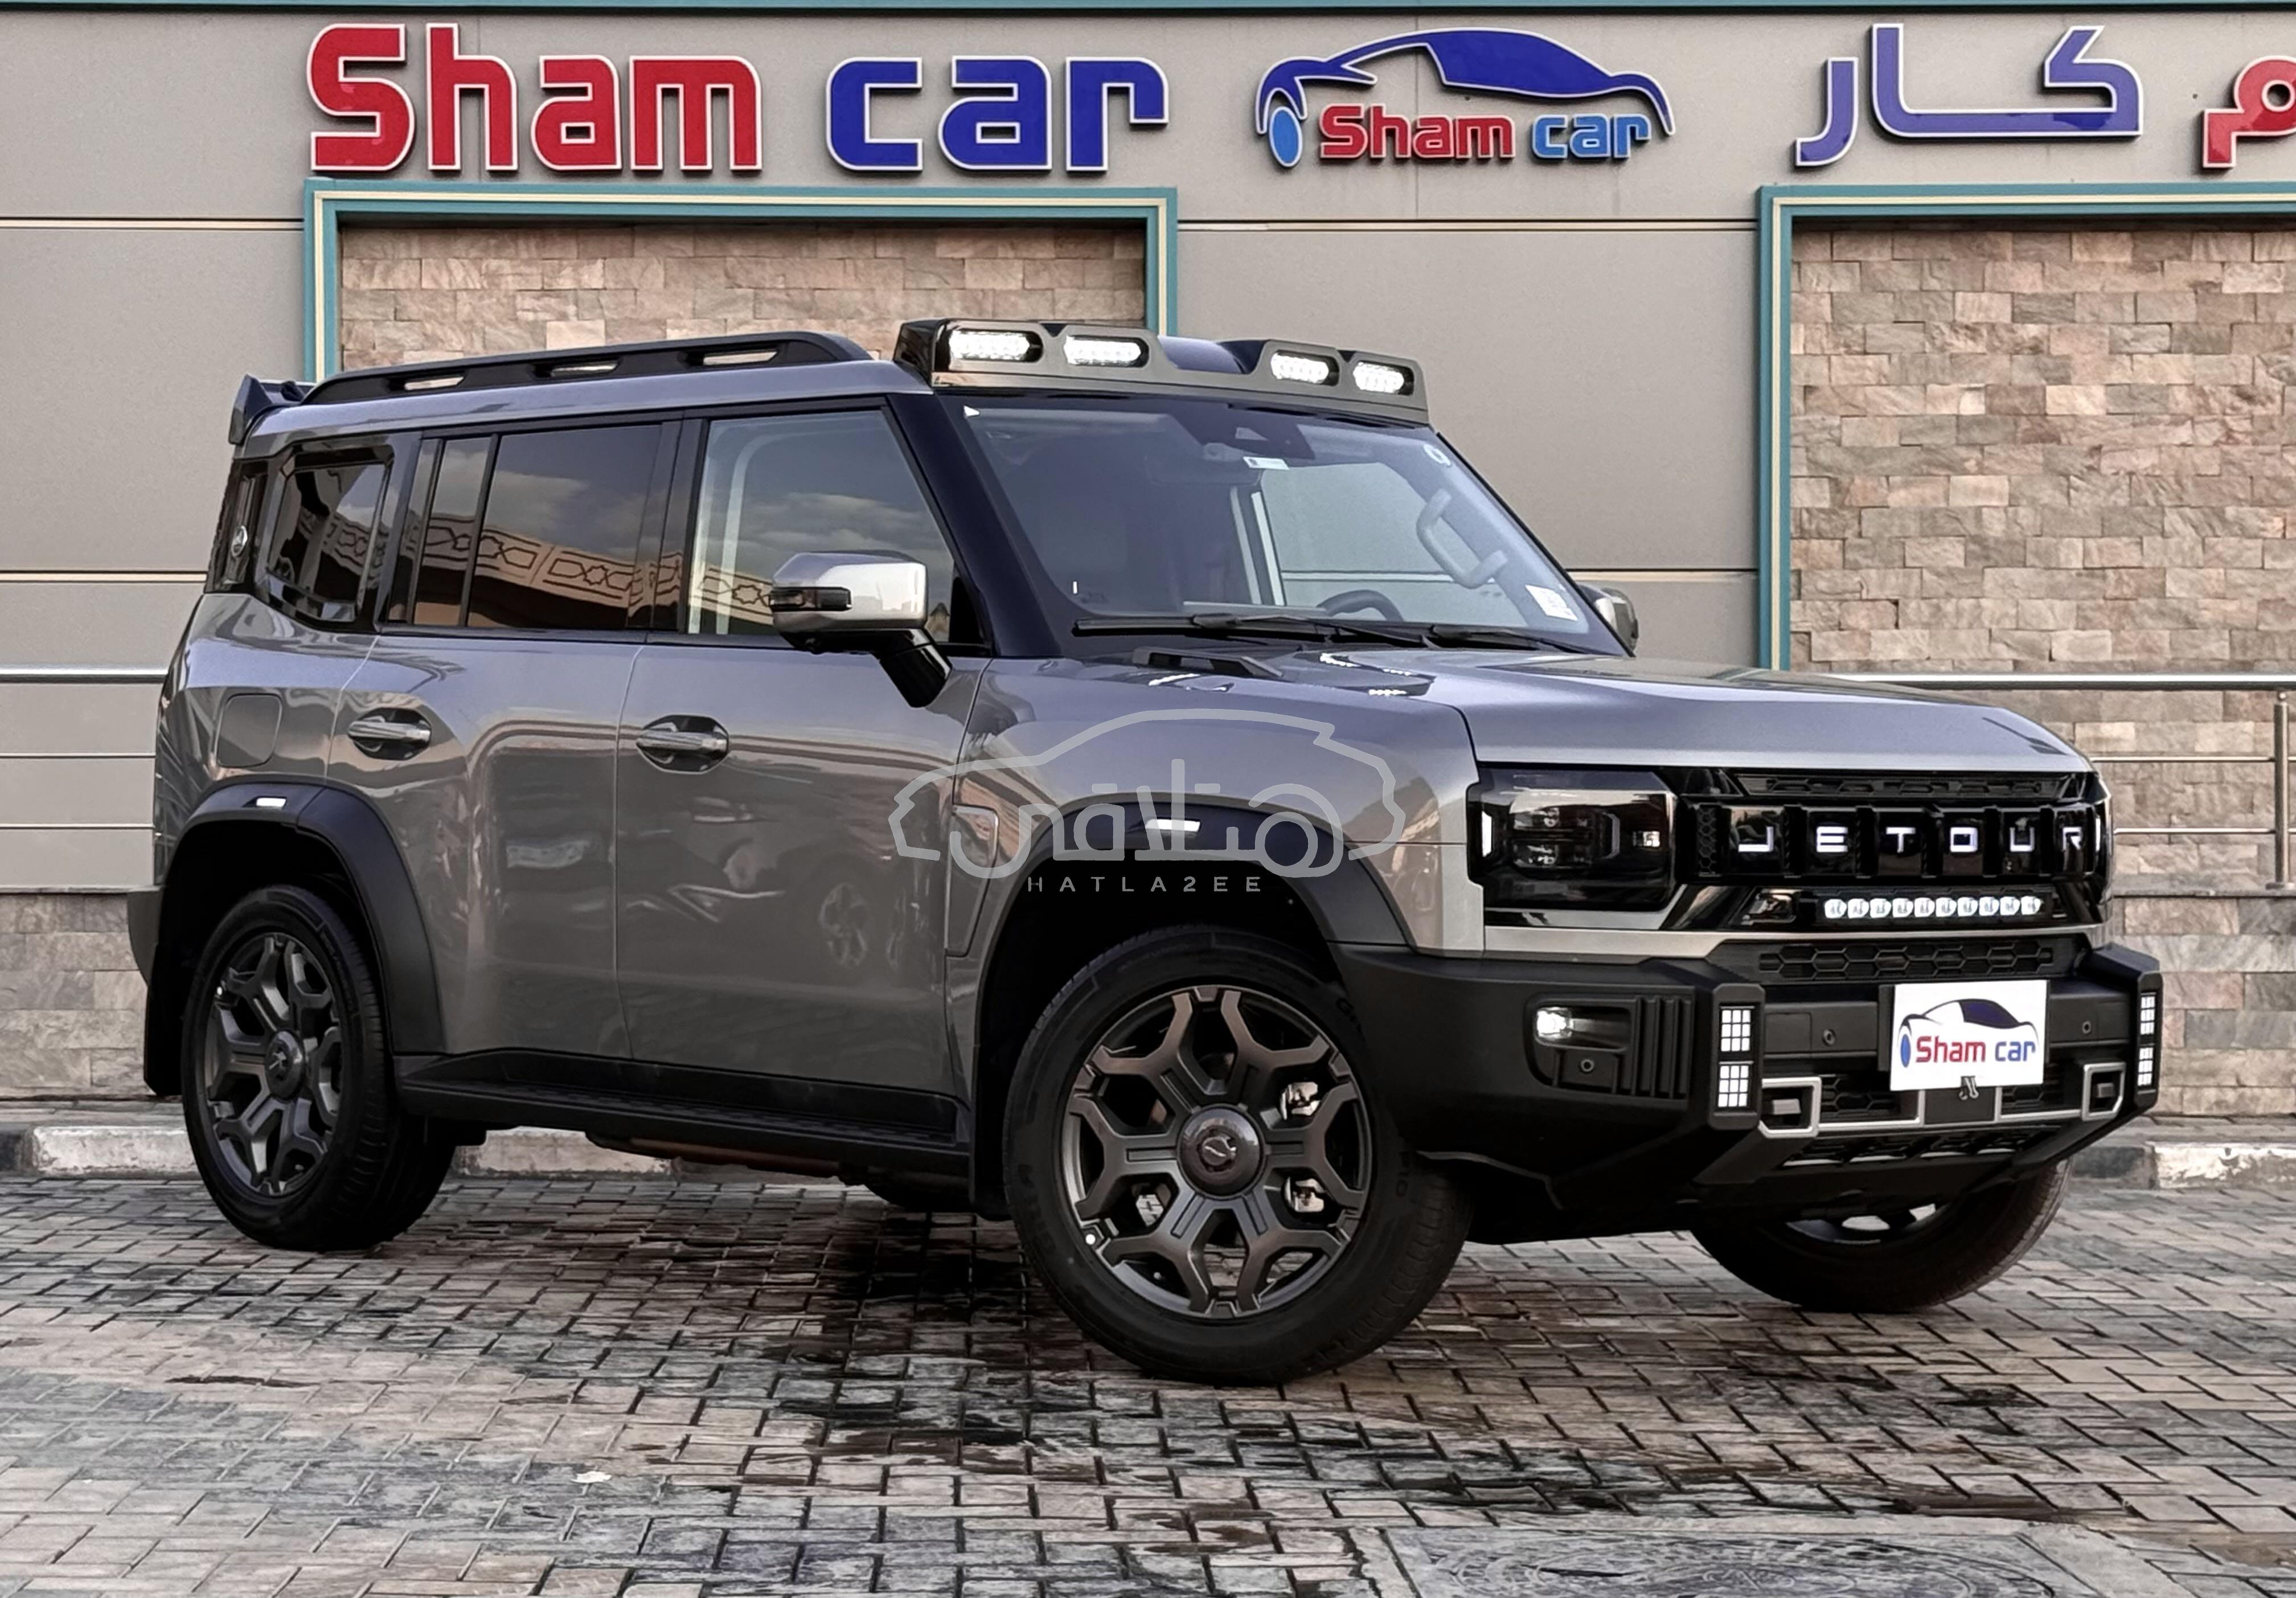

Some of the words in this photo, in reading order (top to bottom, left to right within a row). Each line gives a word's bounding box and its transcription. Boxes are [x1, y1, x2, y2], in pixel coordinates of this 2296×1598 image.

[307, 23, 762, 171] Sham
[826, 56, 1168, 171] car
[1795, 23, 2143, 166] كار
[1319, 103, 1515, 159] Sham
[1532, 114, 1651, 159] car
[1738, 826, 2082, 853] JETOUR
[1915, 1035, 1986, 1063] Sham
[1995, 1041, 2036, 1062] car
